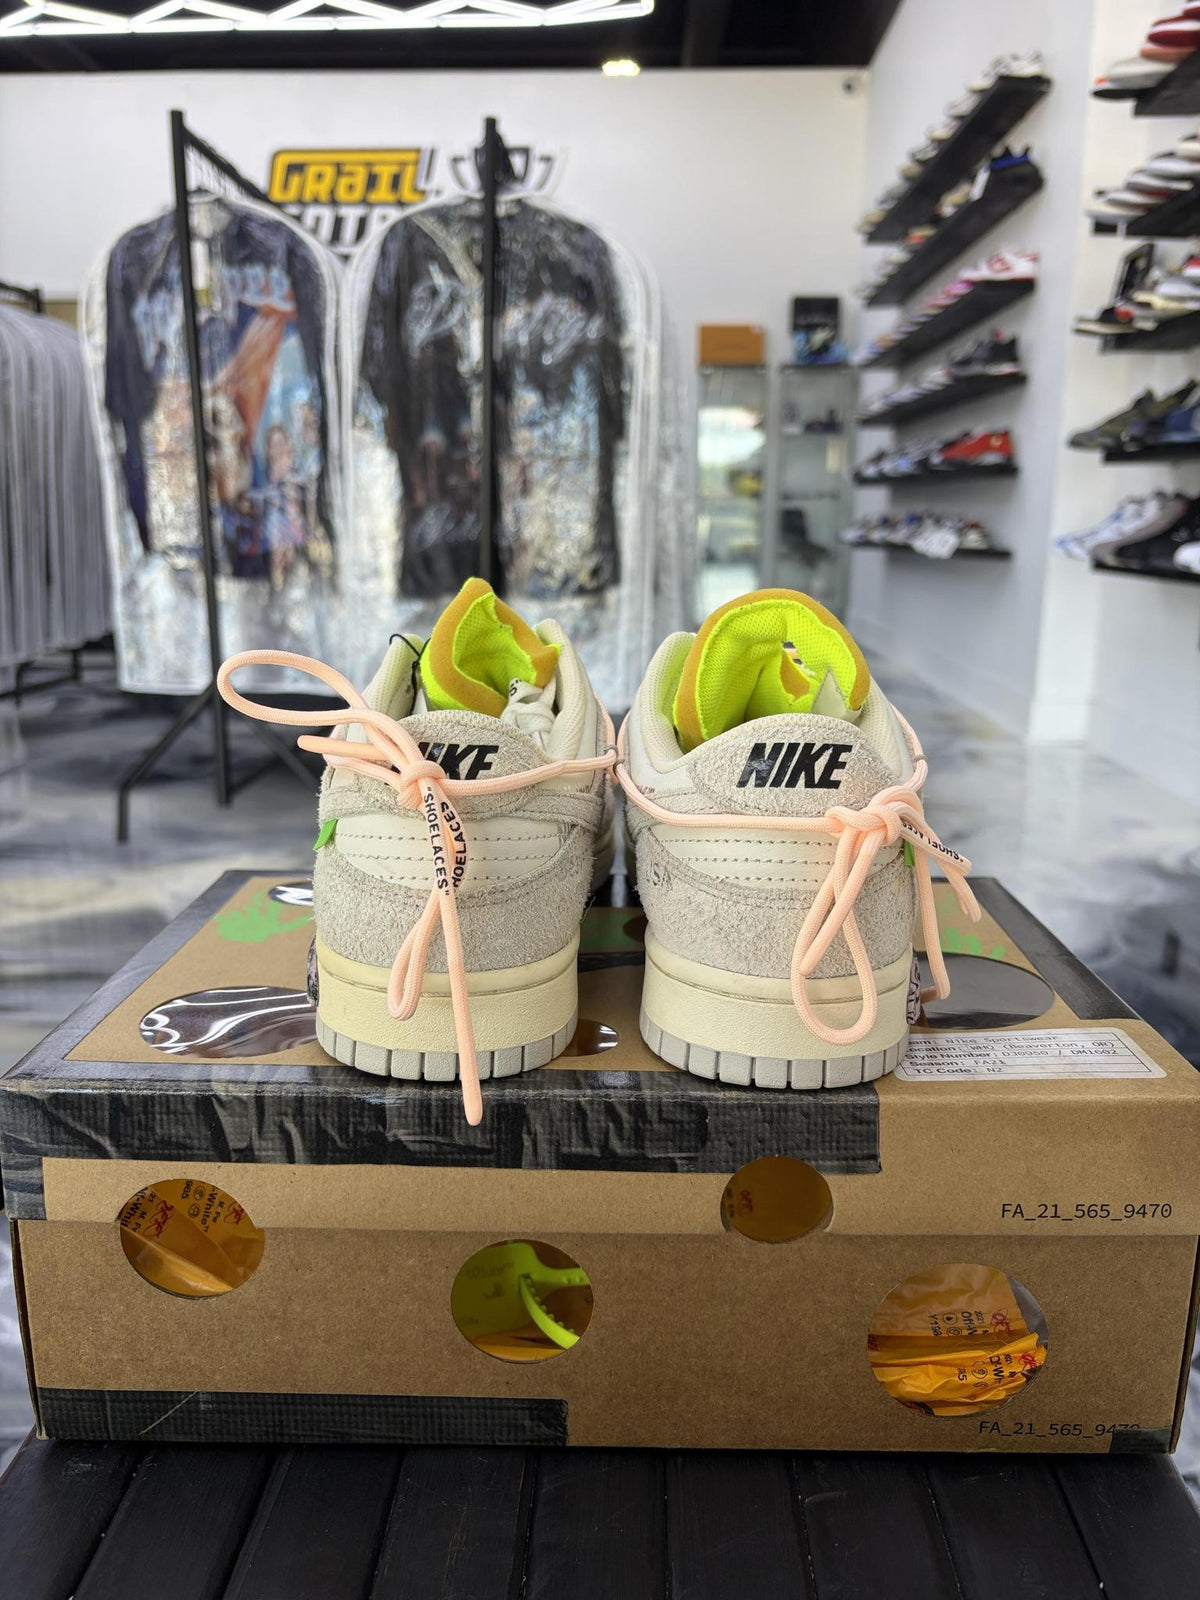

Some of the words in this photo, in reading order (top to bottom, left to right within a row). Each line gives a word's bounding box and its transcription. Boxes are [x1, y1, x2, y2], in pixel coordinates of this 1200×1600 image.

[736, 742, 853, 789] NIKE
[984, 1034, 1058, 1043] Sportswear
[905, 1053, 937, 1061] Style
[940, 1051, 998, 1059] Number:
[1001, 1203, 1172, 1221] FA_21_565_9470
[979, 1420, 1140, 1439] FA_21_565_94
